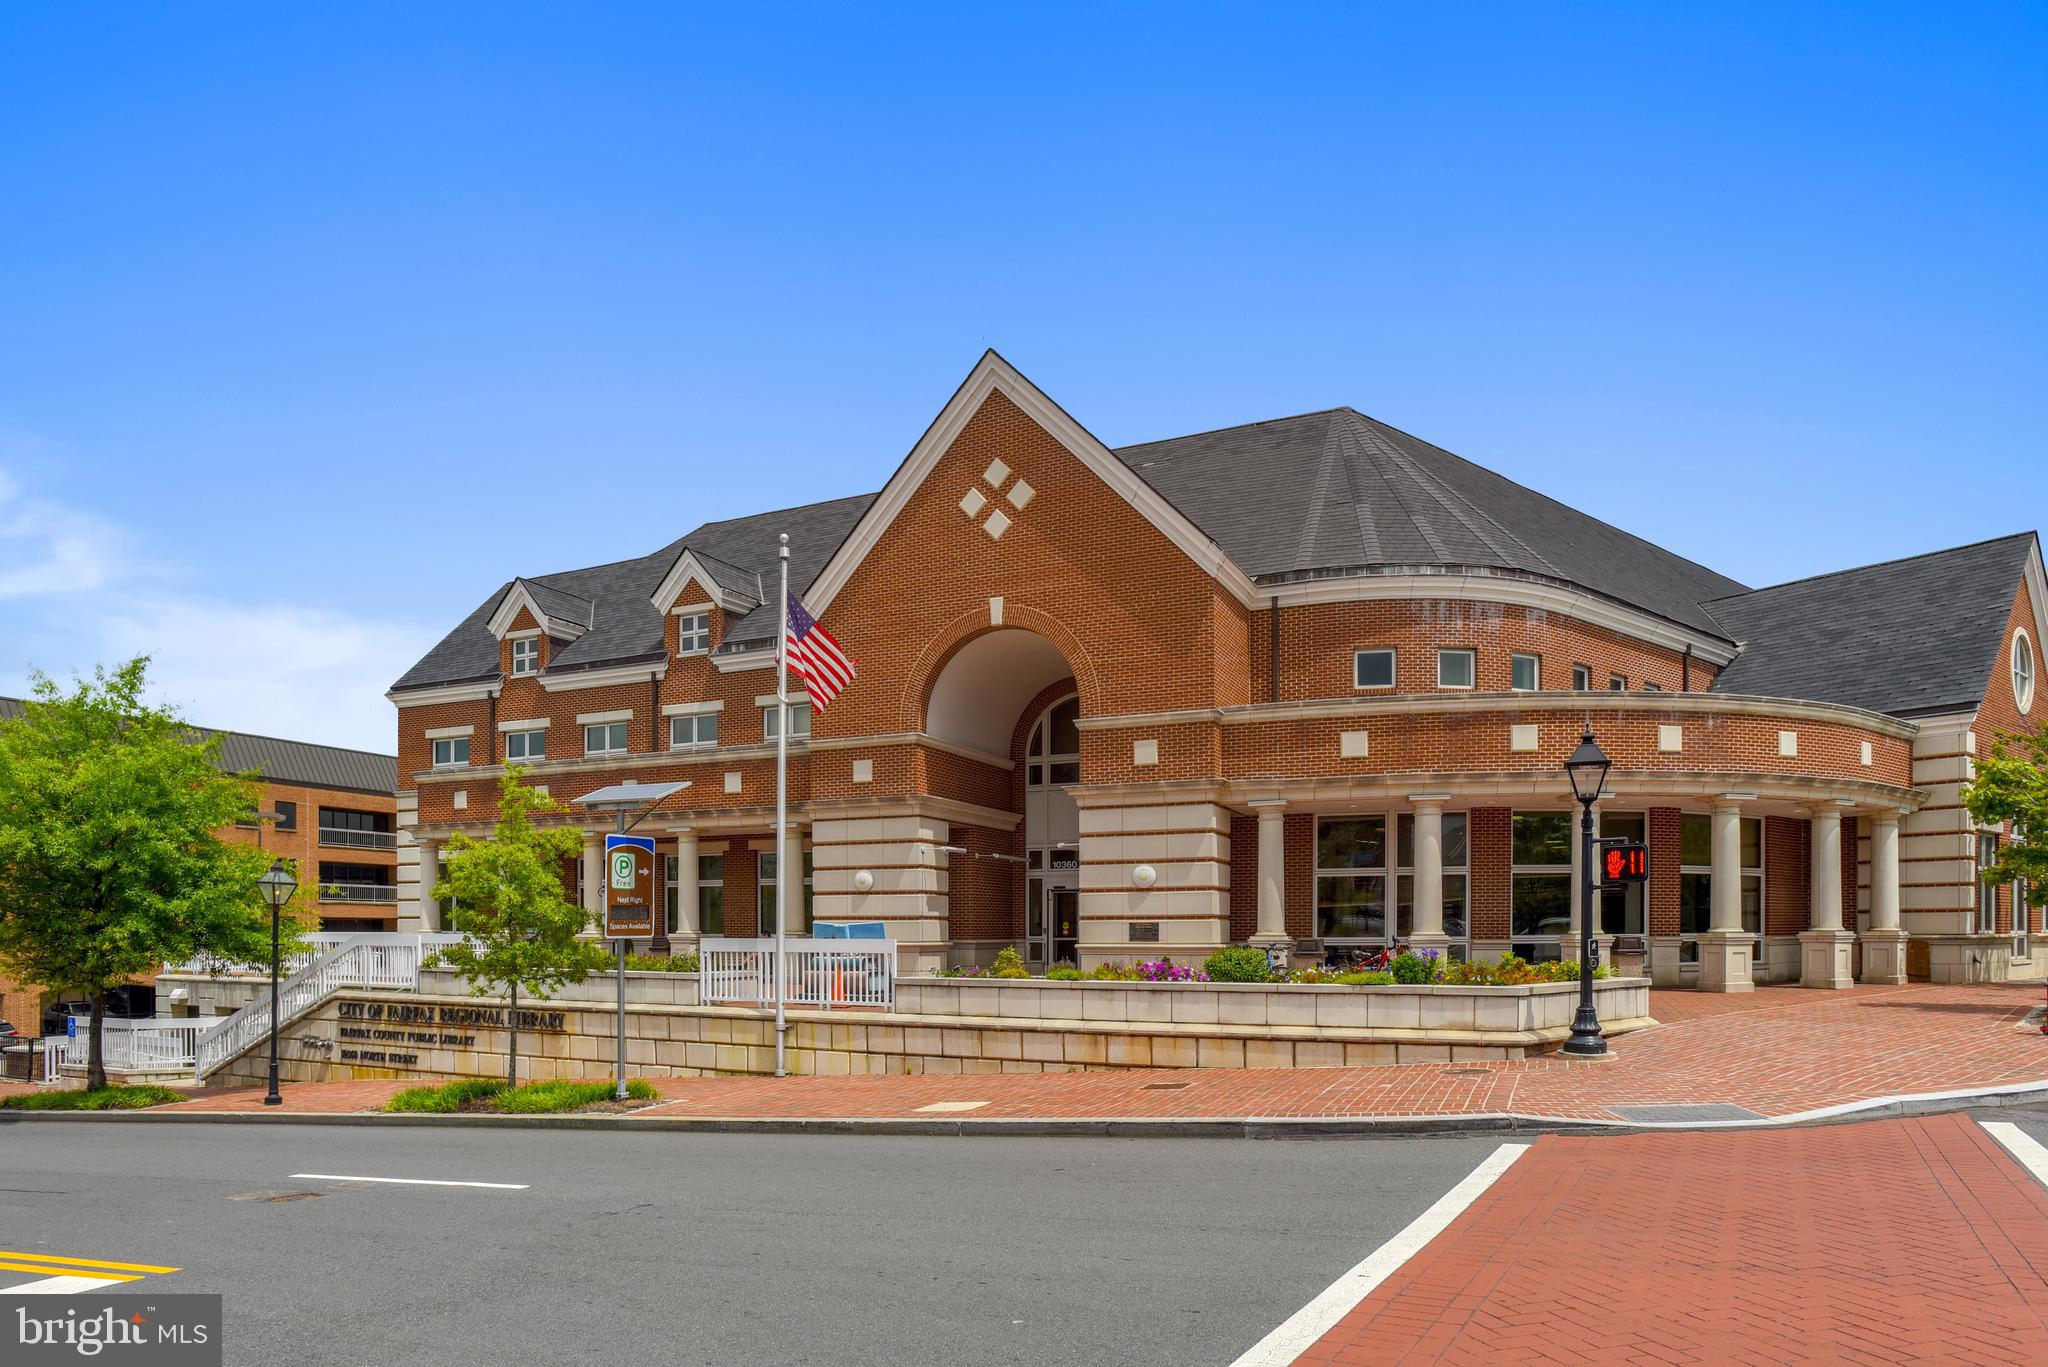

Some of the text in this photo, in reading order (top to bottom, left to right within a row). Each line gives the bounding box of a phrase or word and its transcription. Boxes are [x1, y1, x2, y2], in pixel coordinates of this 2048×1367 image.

[619, 860, 629, 874] P
[1052, 861, 1077, 869] 10360
[1630, 850, 1644, 875] 11
[616, 879, 632, 887] Free
[609, 923, 628, 931] Spaces
[338, 1003, 364, 1016] CITY
[367, 1004, 384, 1018] OF
[387, 1006, 435, 1022] FAIRFAX
[440, 1008, 504, 1026] REGIONAL
[340, 1028, 475, 1046] FAIRFAX COUNTY PUBLIC LIBRARY
[360, 1051, 387, 1063] NORTH
[388, 1054, 418, 1065] STREET
